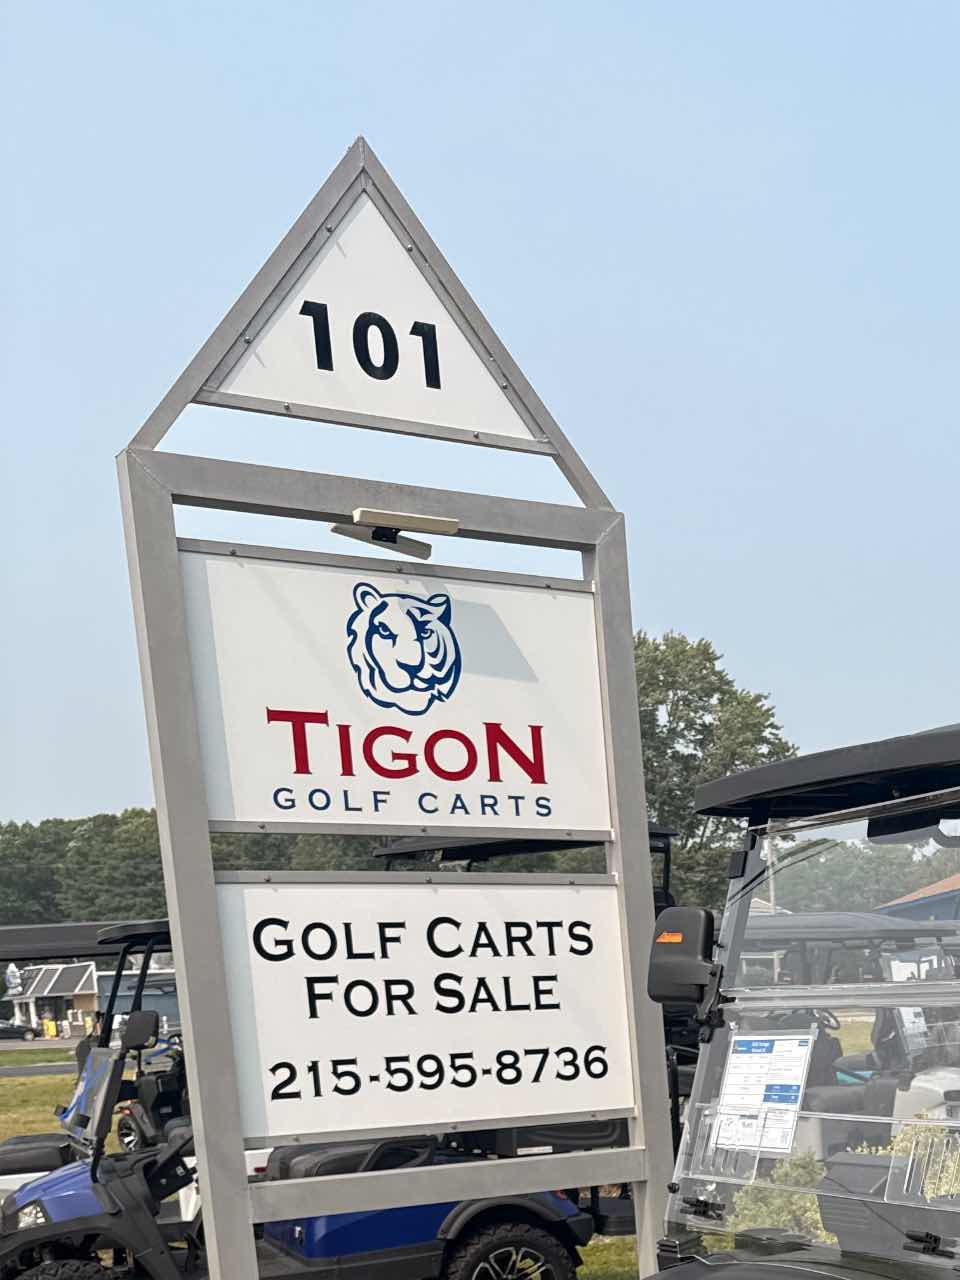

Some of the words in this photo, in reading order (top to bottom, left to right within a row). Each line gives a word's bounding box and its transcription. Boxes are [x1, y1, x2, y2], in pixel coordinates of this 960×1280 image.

[299, 300, 442, 390] 101
[266, 706, 548, 785] TIGON
[272, 787, 391, 813] GOLF
[417, 792, 553, 818] CARTS
[252, 917, 407, 962] GOLF
[426, 915, 594, 959] CARTS
[304, 974, 418, 1020] FOR
[433, 972, 561, 1015] SALE
[268, 1044, 610, 1101] 215-595-8736
